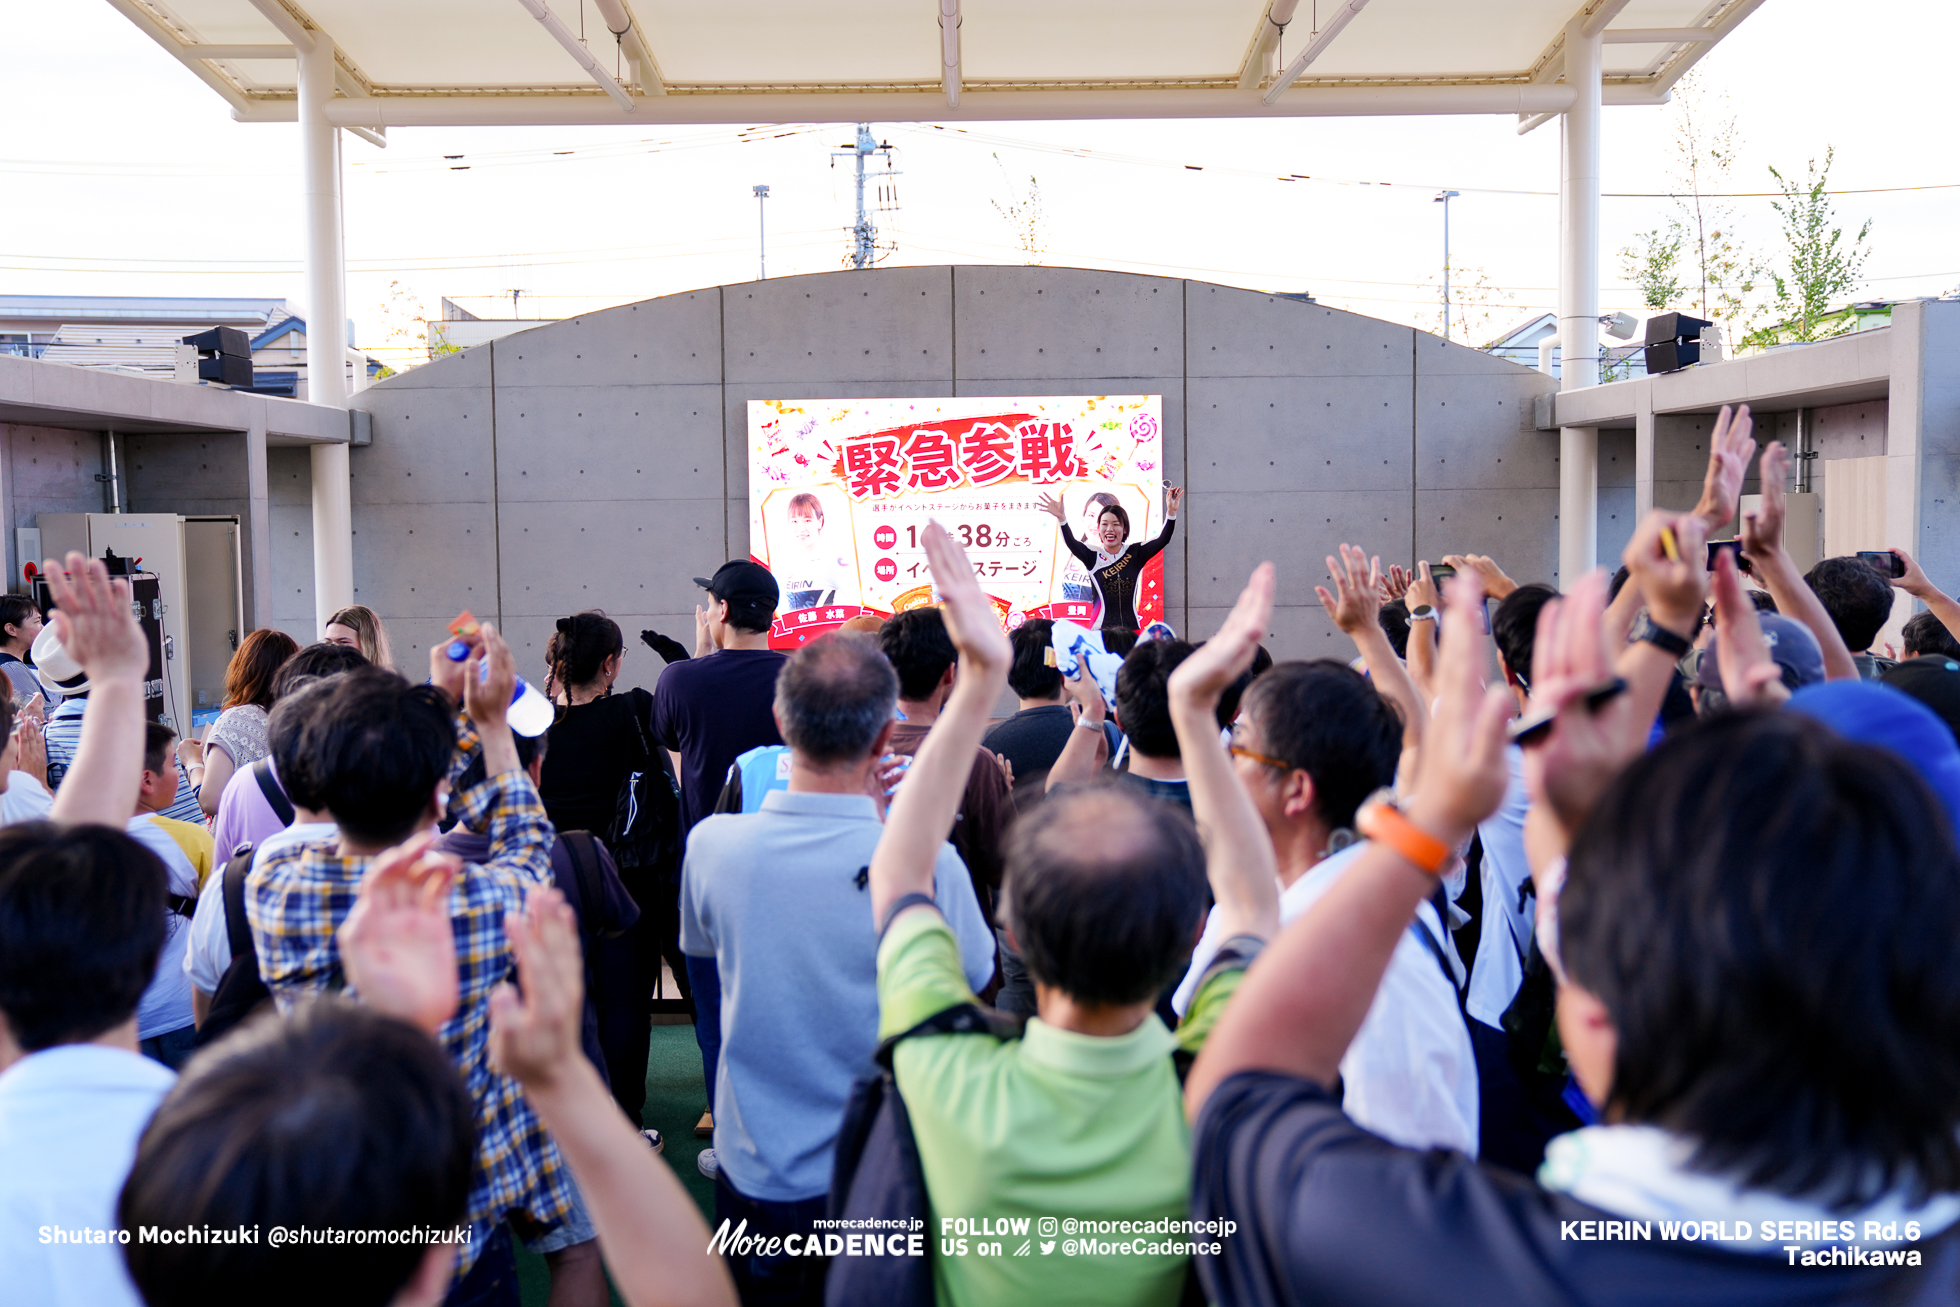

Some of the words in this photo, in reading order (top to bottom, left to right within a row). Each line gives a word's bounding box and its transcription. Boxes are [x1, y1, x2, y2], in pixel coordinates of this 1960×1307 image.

[845, 422, 1075, 497] 緊急参戦
[877, 533, 894, 542] 時間
[906, 524, 1031, 548] 138分ごろ
[877, 565, 894, 575] 場所
[906, 560, 1037, 578] イステージ
[1101, 553, 1132, 579] KEIRIN
[784, 579, 814, 590] EIRIN
[904, 596, 928, 611] Cookies
